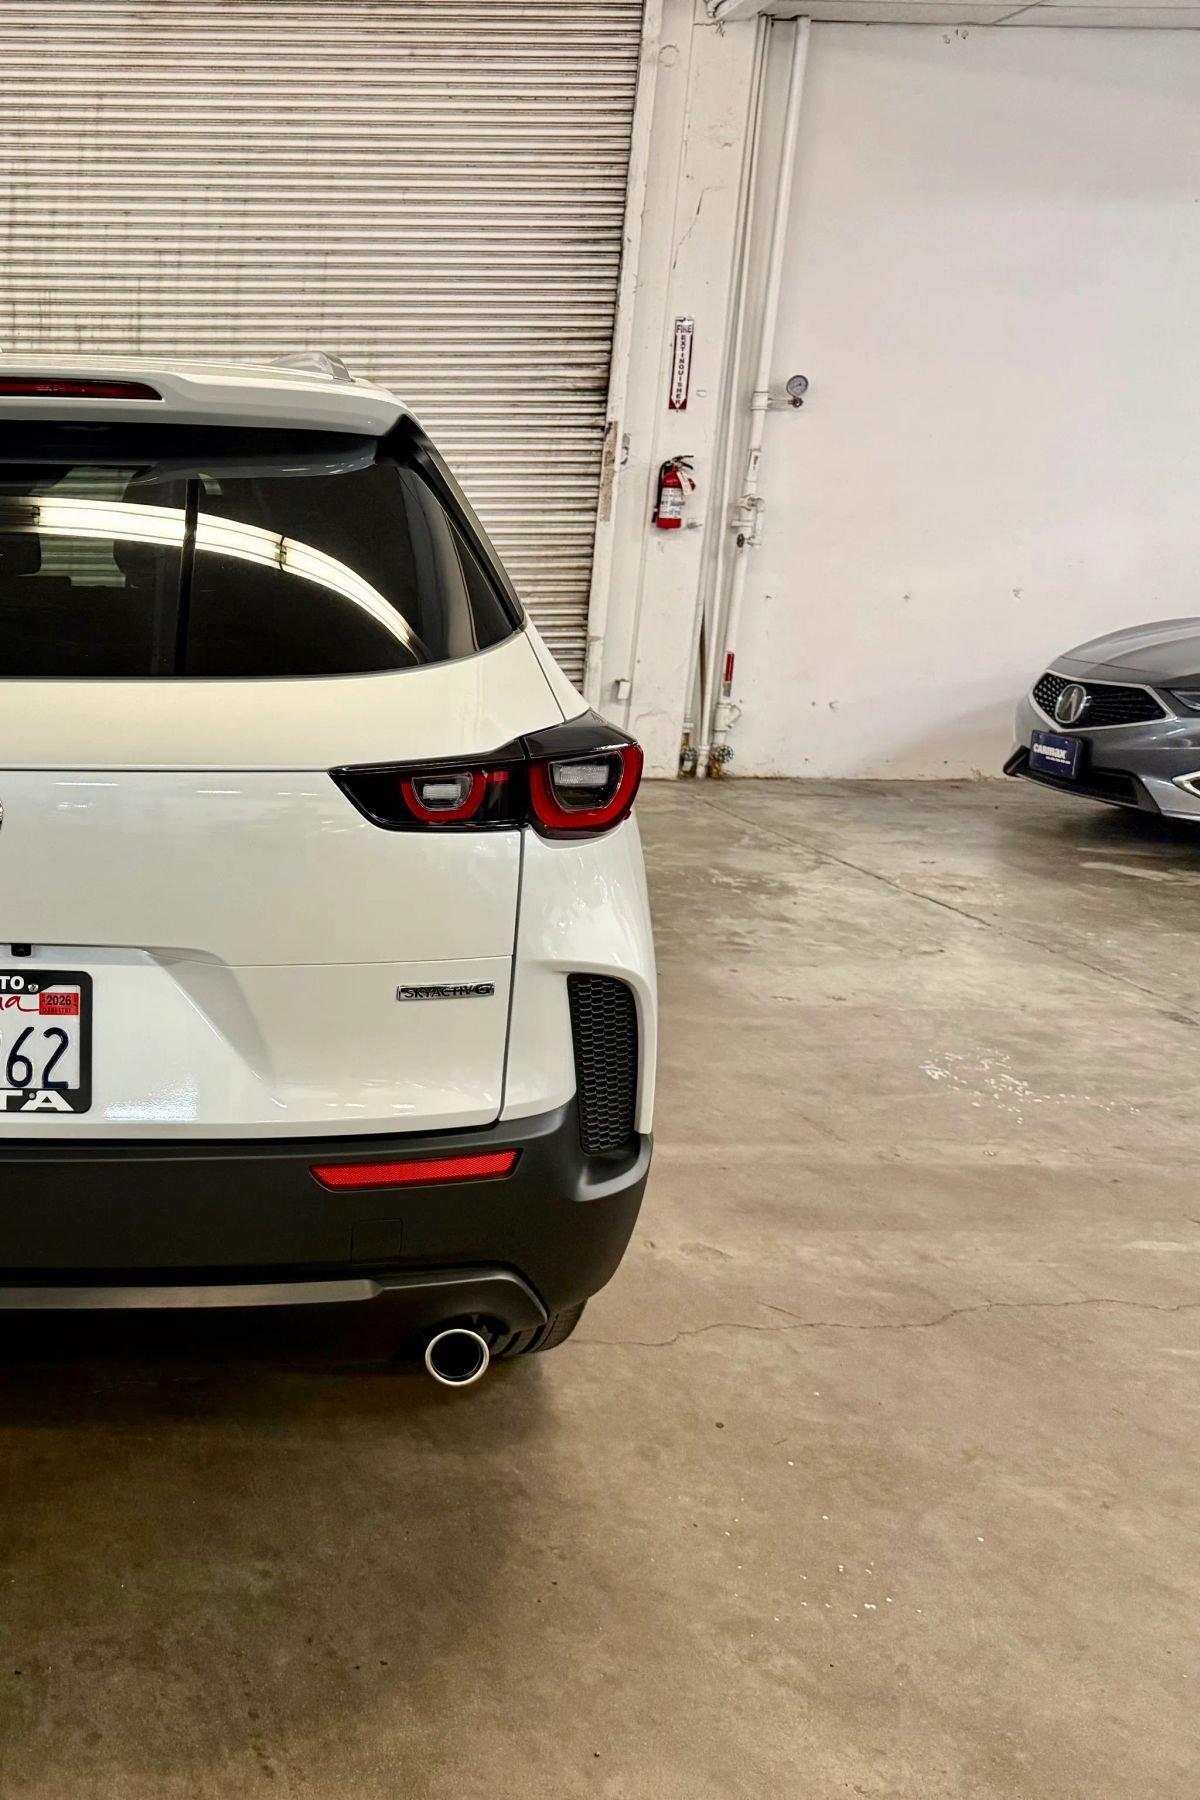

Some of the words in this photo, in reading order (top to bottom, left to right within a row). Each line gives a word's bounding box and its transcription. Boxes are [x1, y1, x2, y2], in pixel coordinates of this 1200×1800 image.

[676, 325, 692, 333] FIRE
[675, 334, 686, 404] EXTINGUISHER
[46, 995, 72, 1006] 2026
